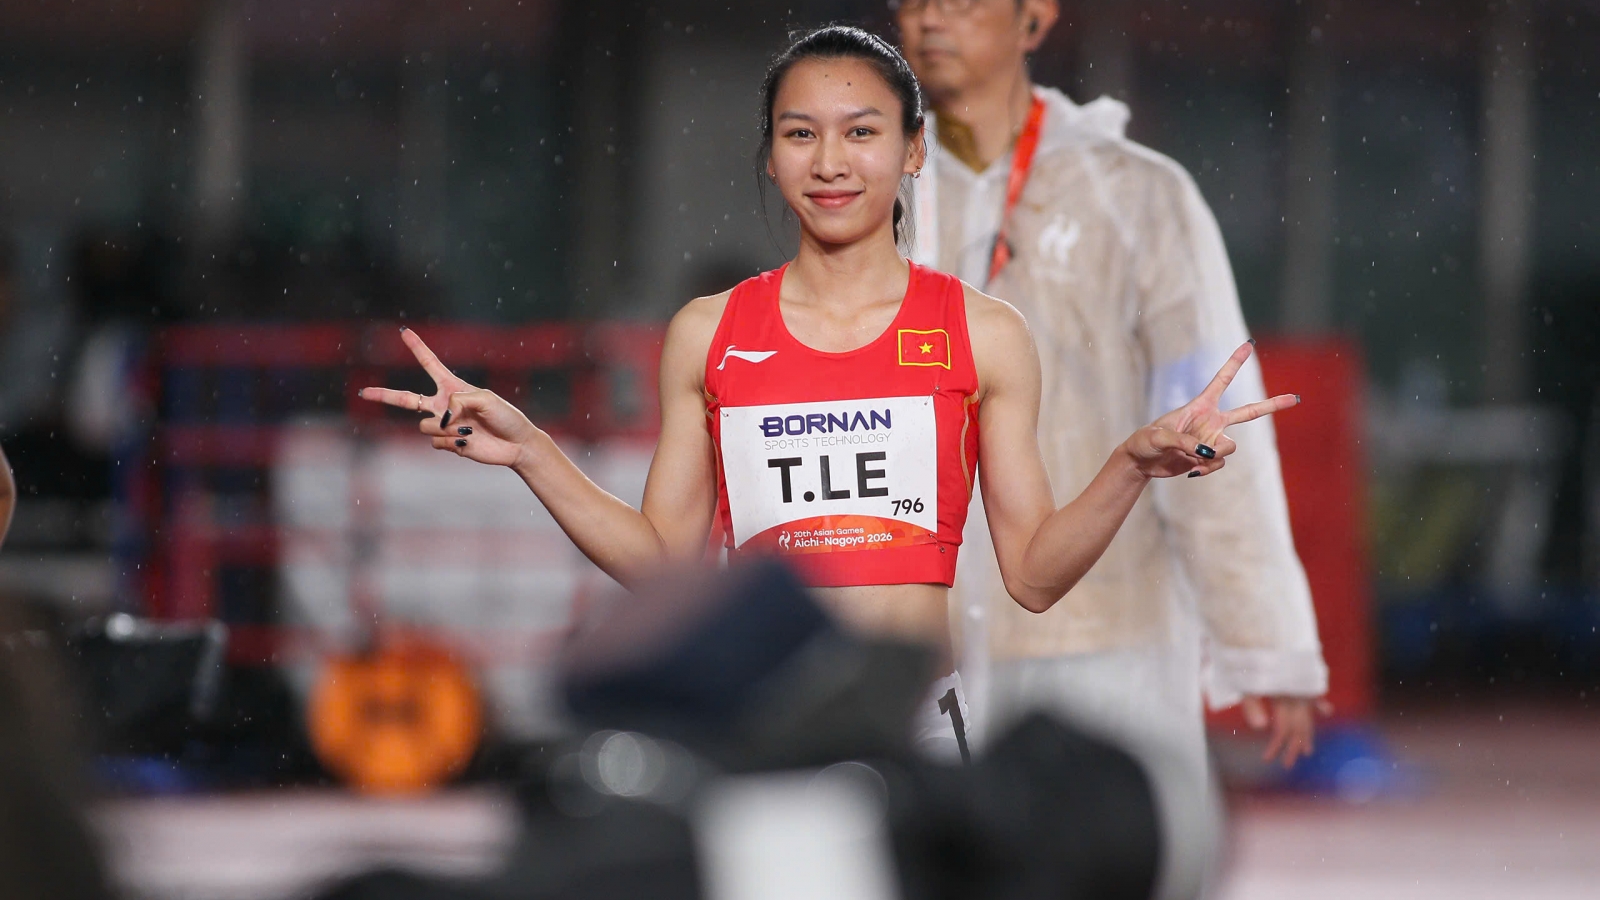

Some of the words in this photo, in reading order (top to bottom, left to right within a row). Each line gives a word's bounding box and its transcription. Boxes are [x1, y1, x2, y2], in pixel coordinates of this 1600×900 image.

[759, 409, 892, 437] BORNAN
[765, 438, 809, 450] SPORTS
[815, 432, 892, 447] TECHNOLOGY
[767, 451, 889, 503] T.LE
[891, 498, 924, 516] 796
[793, 530, 812, 538] 20th
[794, 535, 865, 548] Aichi-Nagoya
[867, 533, 893, 542] 2026
